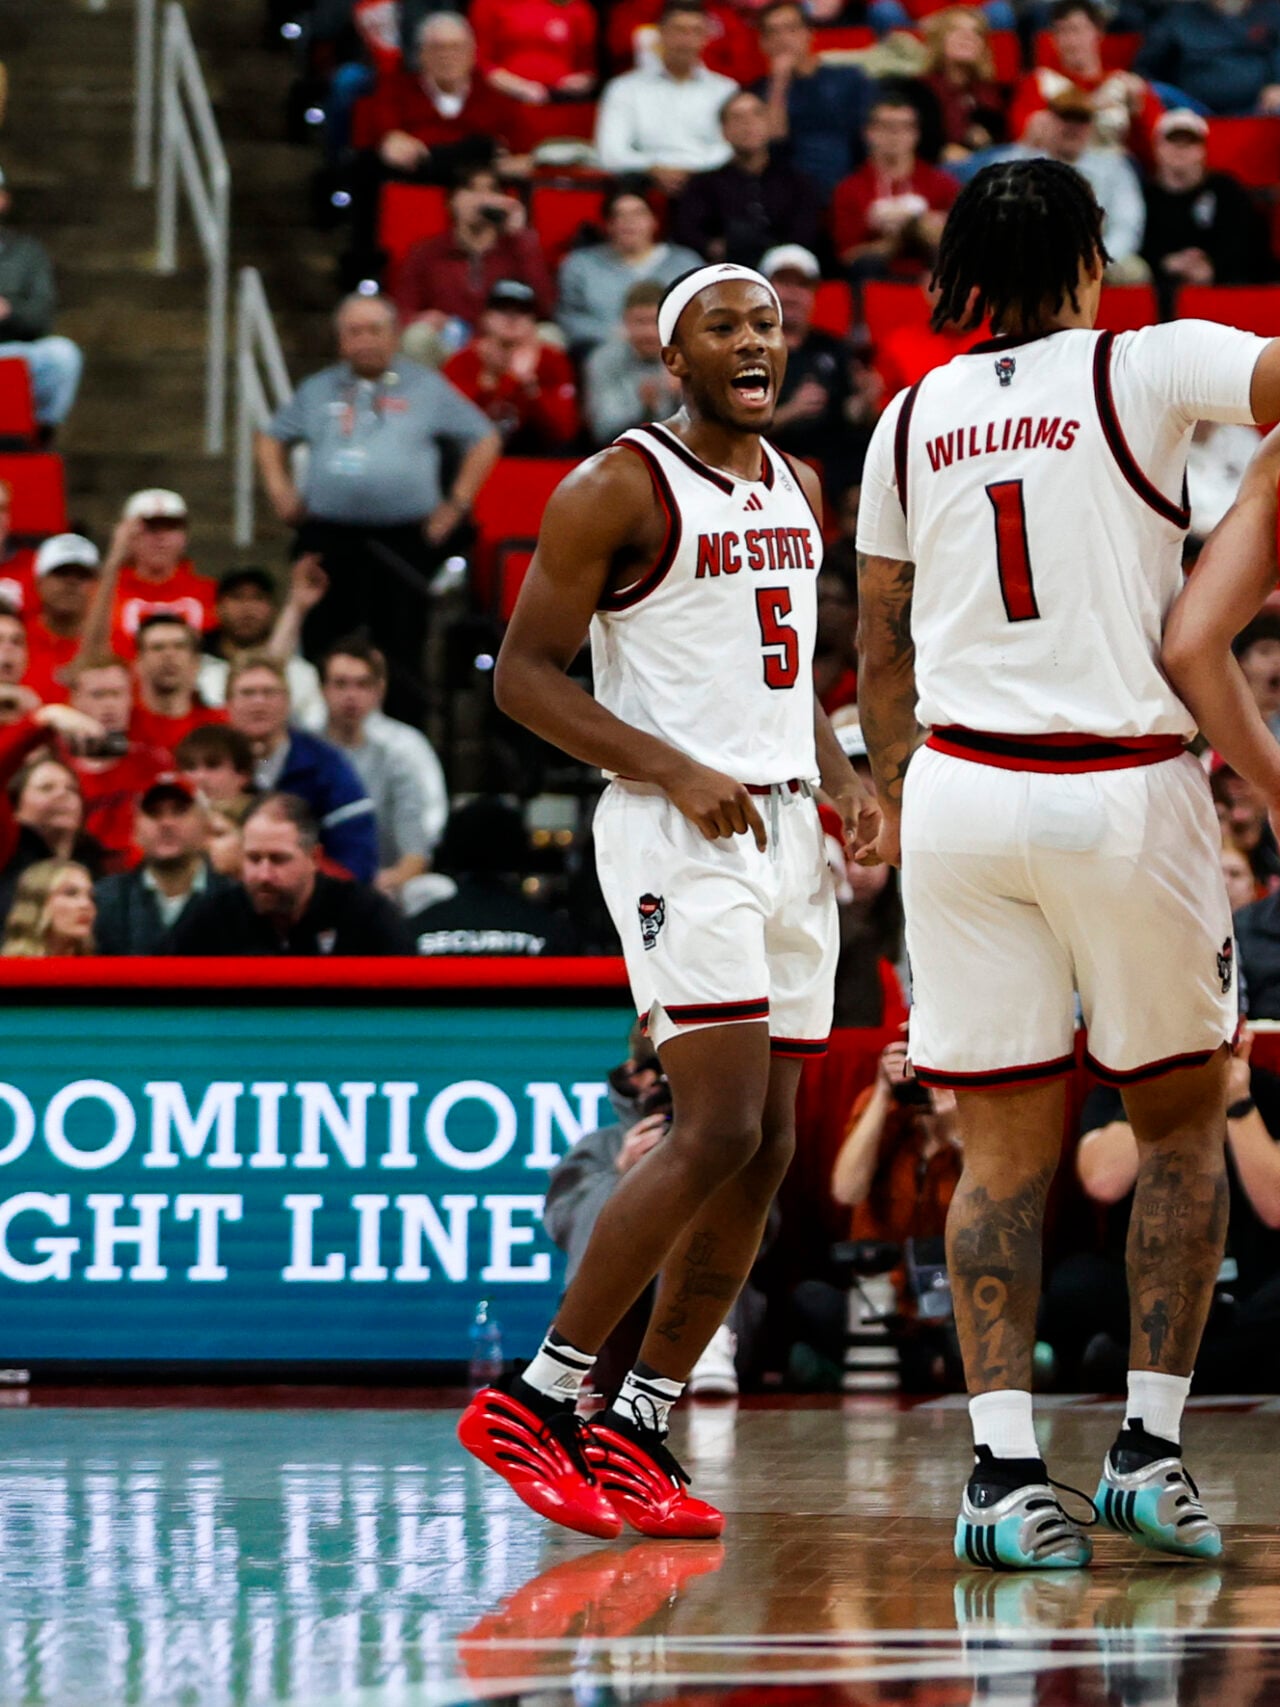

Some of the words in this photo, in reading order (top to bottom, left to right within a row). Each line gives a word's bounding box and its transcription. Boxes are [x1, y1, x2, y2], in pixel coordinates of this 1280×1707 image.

[925, 416, 1080, 473] WILLIAMS
[695, 530, 742, 579] NC
[744, 527, 815, 571] STATE
[984, 478, 1040, 622] 1
[755, 586, 799, 690] 5
[282, 1194, 552, 1283] LINE
